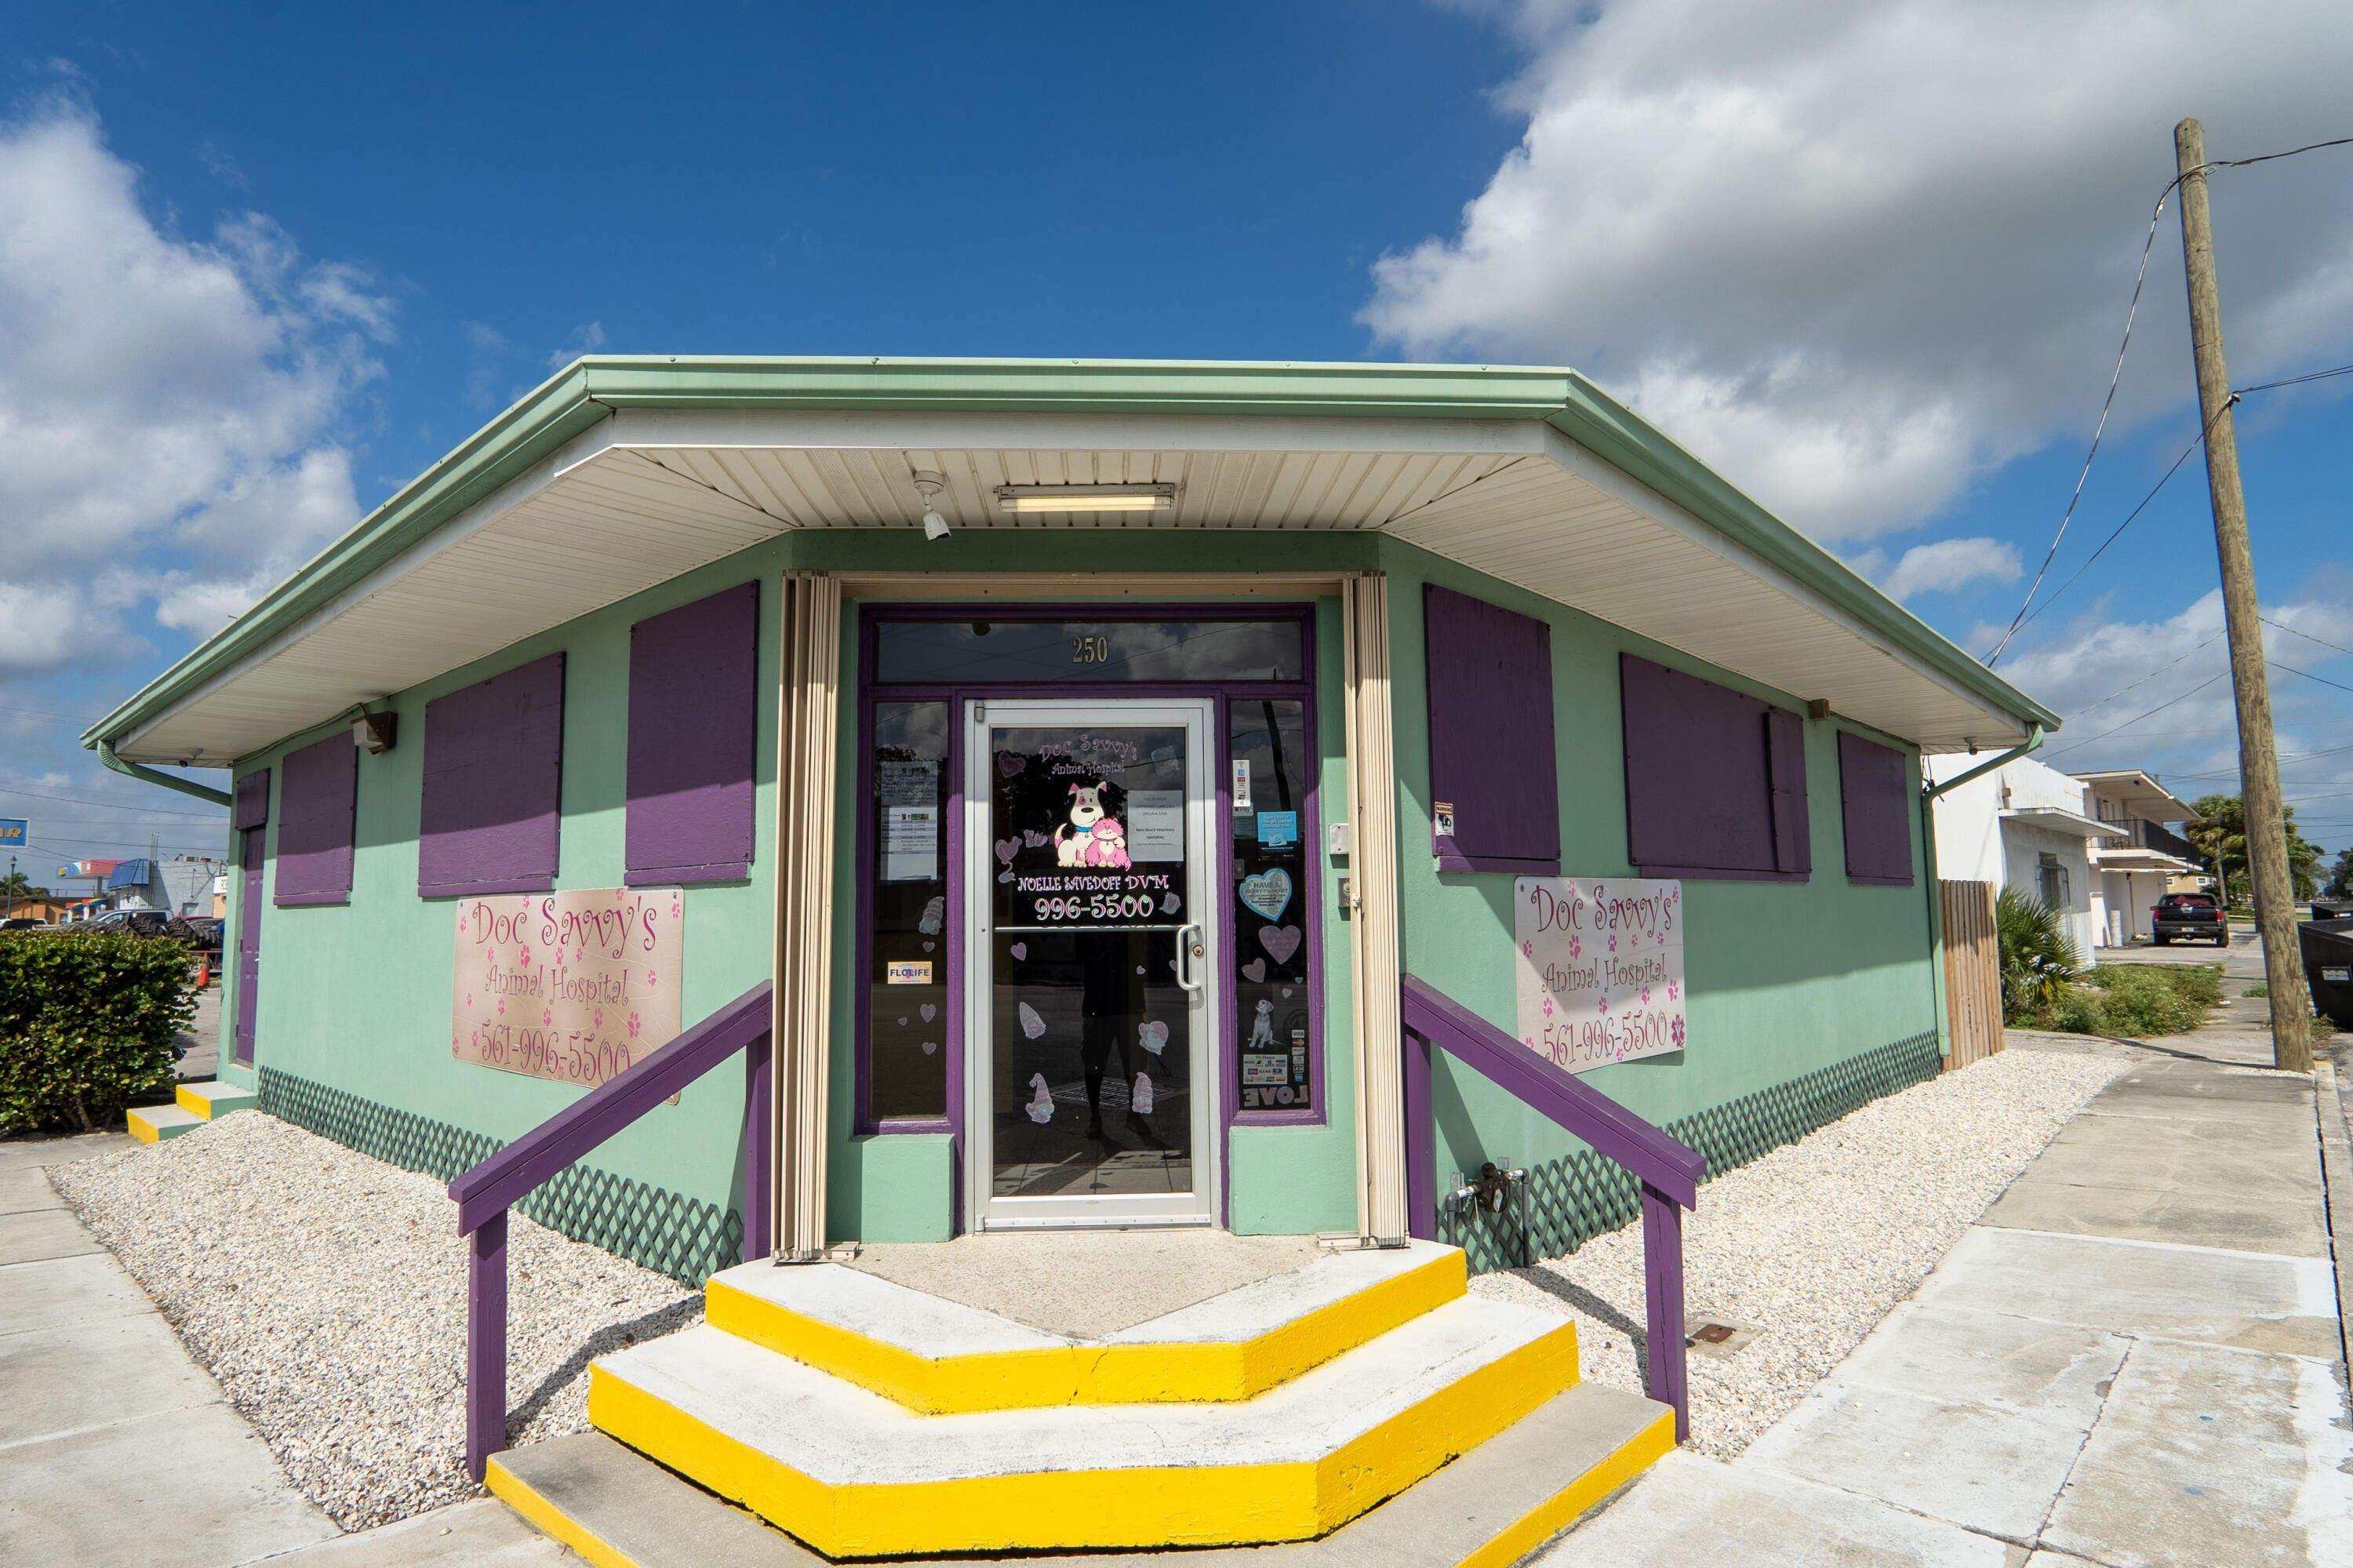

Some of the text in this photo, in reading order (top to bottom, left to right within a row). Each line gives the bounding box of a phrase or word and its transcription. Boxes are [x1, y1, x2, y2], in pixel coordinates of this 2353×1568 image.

[1072, 636, 1107, 664] 250
[1051, 759, 1125, 777] Animal Hospital
[1017, 875, 1169, 892] NOELLE SAVEDOFF DVM
[471, 896, 657, 959] Doc Savvy's
[1035, 893, 1154, 921] 996-5500
[1530, 885, 1672, 938] Doc Savvy's
[485, 964, 629, 1010] Animal Hospital
[1541, 953, 1667, 993] Animal Hospital
[481, 1019, 631, 1082] 561-996-5500
[1543, 1010, 1668, 1066] 561-996-5500
